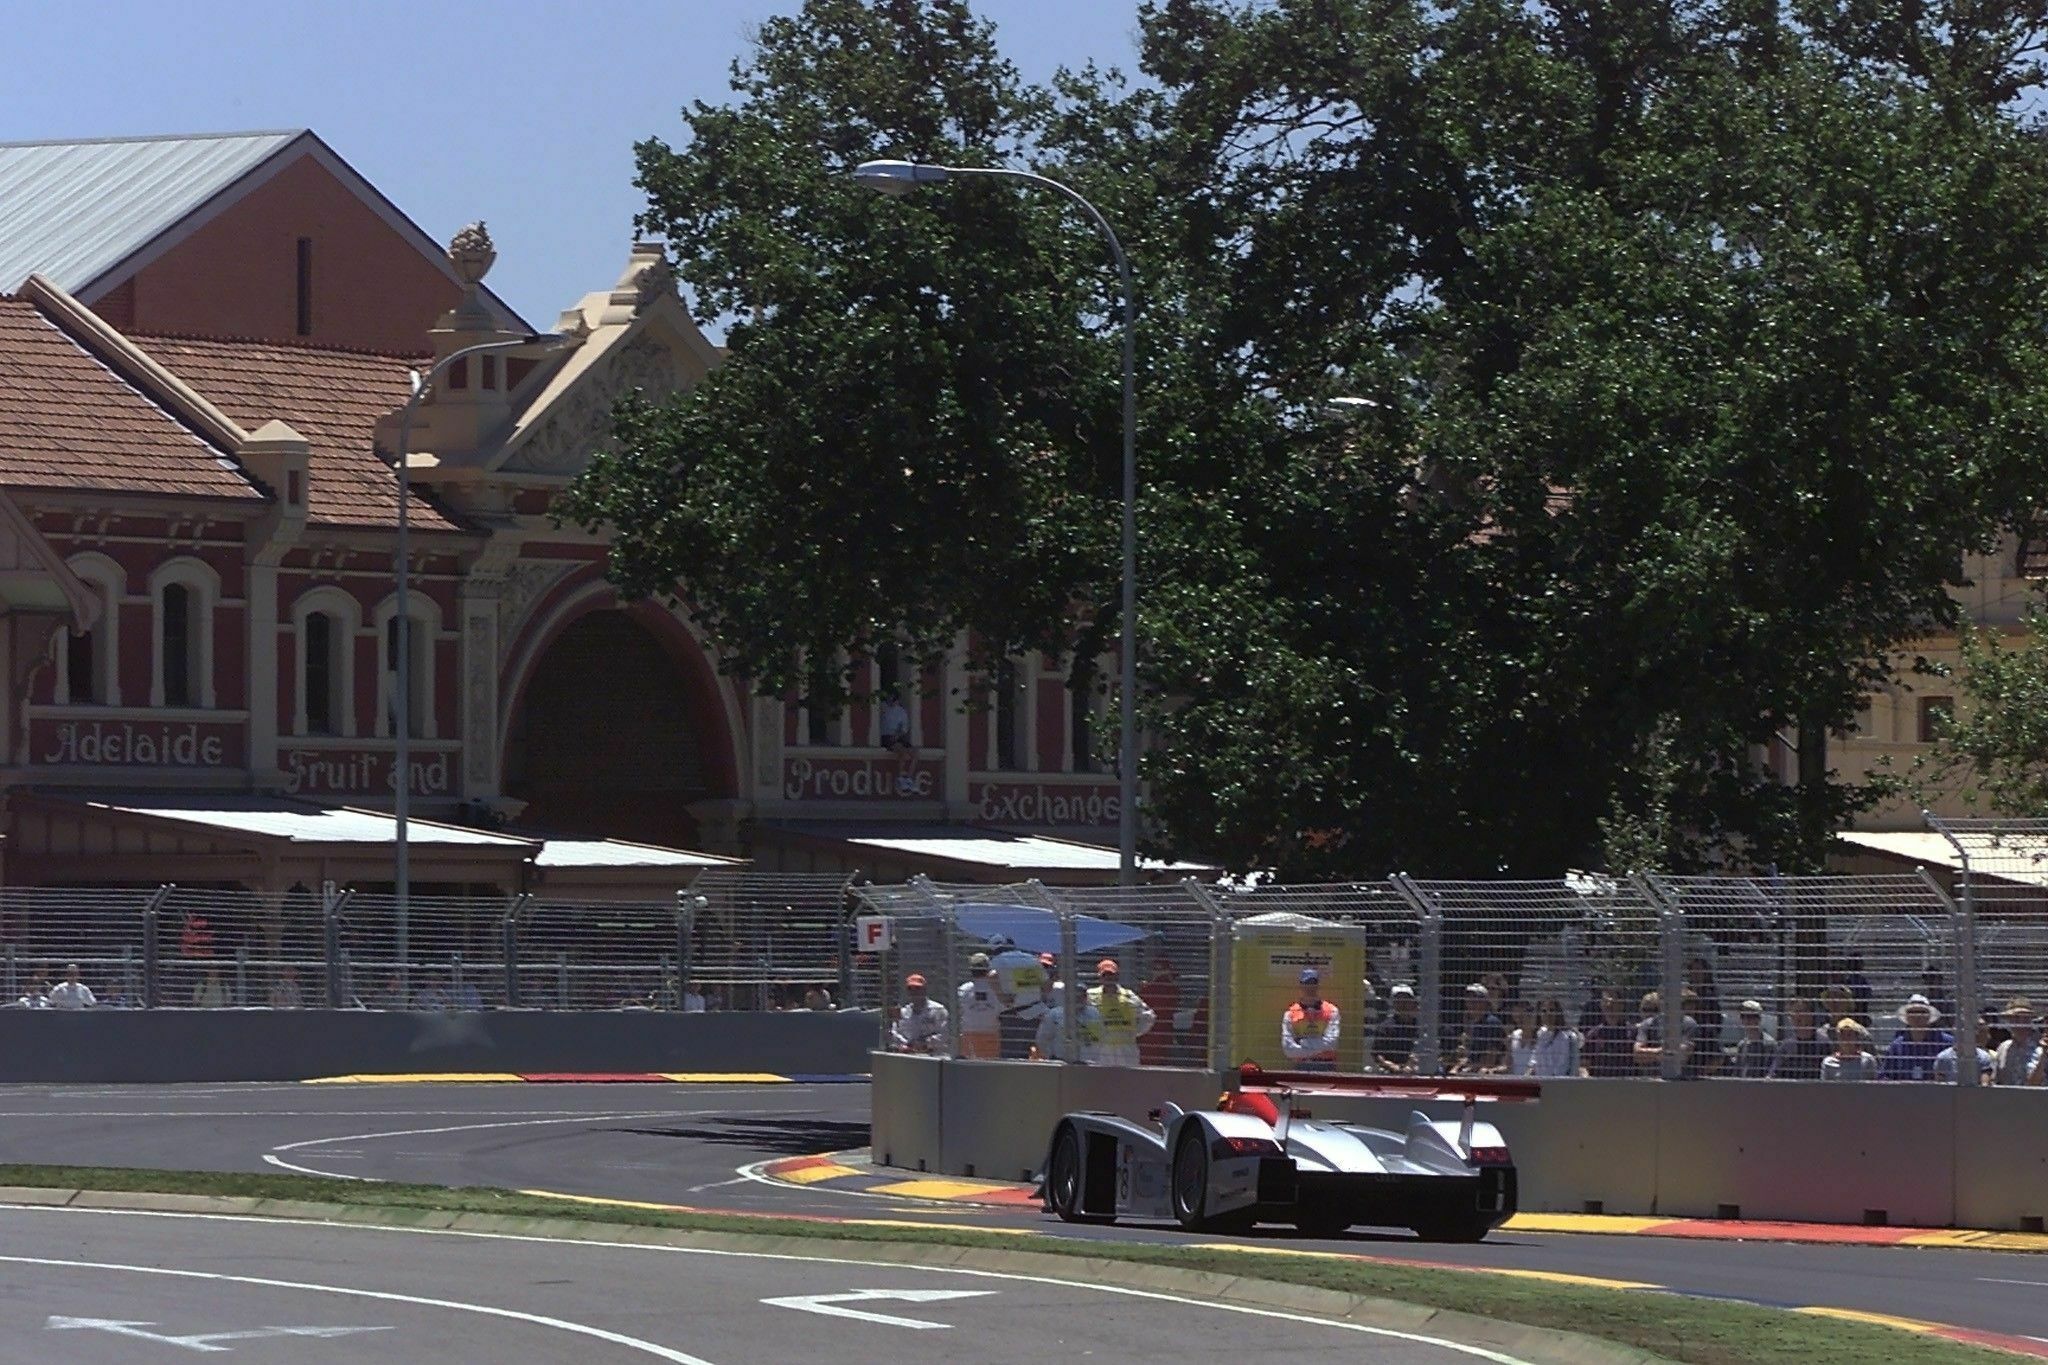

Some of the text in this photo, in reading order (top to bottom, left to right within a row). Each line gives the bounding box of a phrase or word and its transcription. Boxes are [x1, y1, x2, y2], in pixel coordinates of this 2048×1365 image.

[44, 721, 222, 764] Adelaide
[284, 751, 378, 793] Fruit
[785, 758, 932, 800] Produe
[980, 783, 1121, 826] Exchange
[867, 923, 882, 944] F
